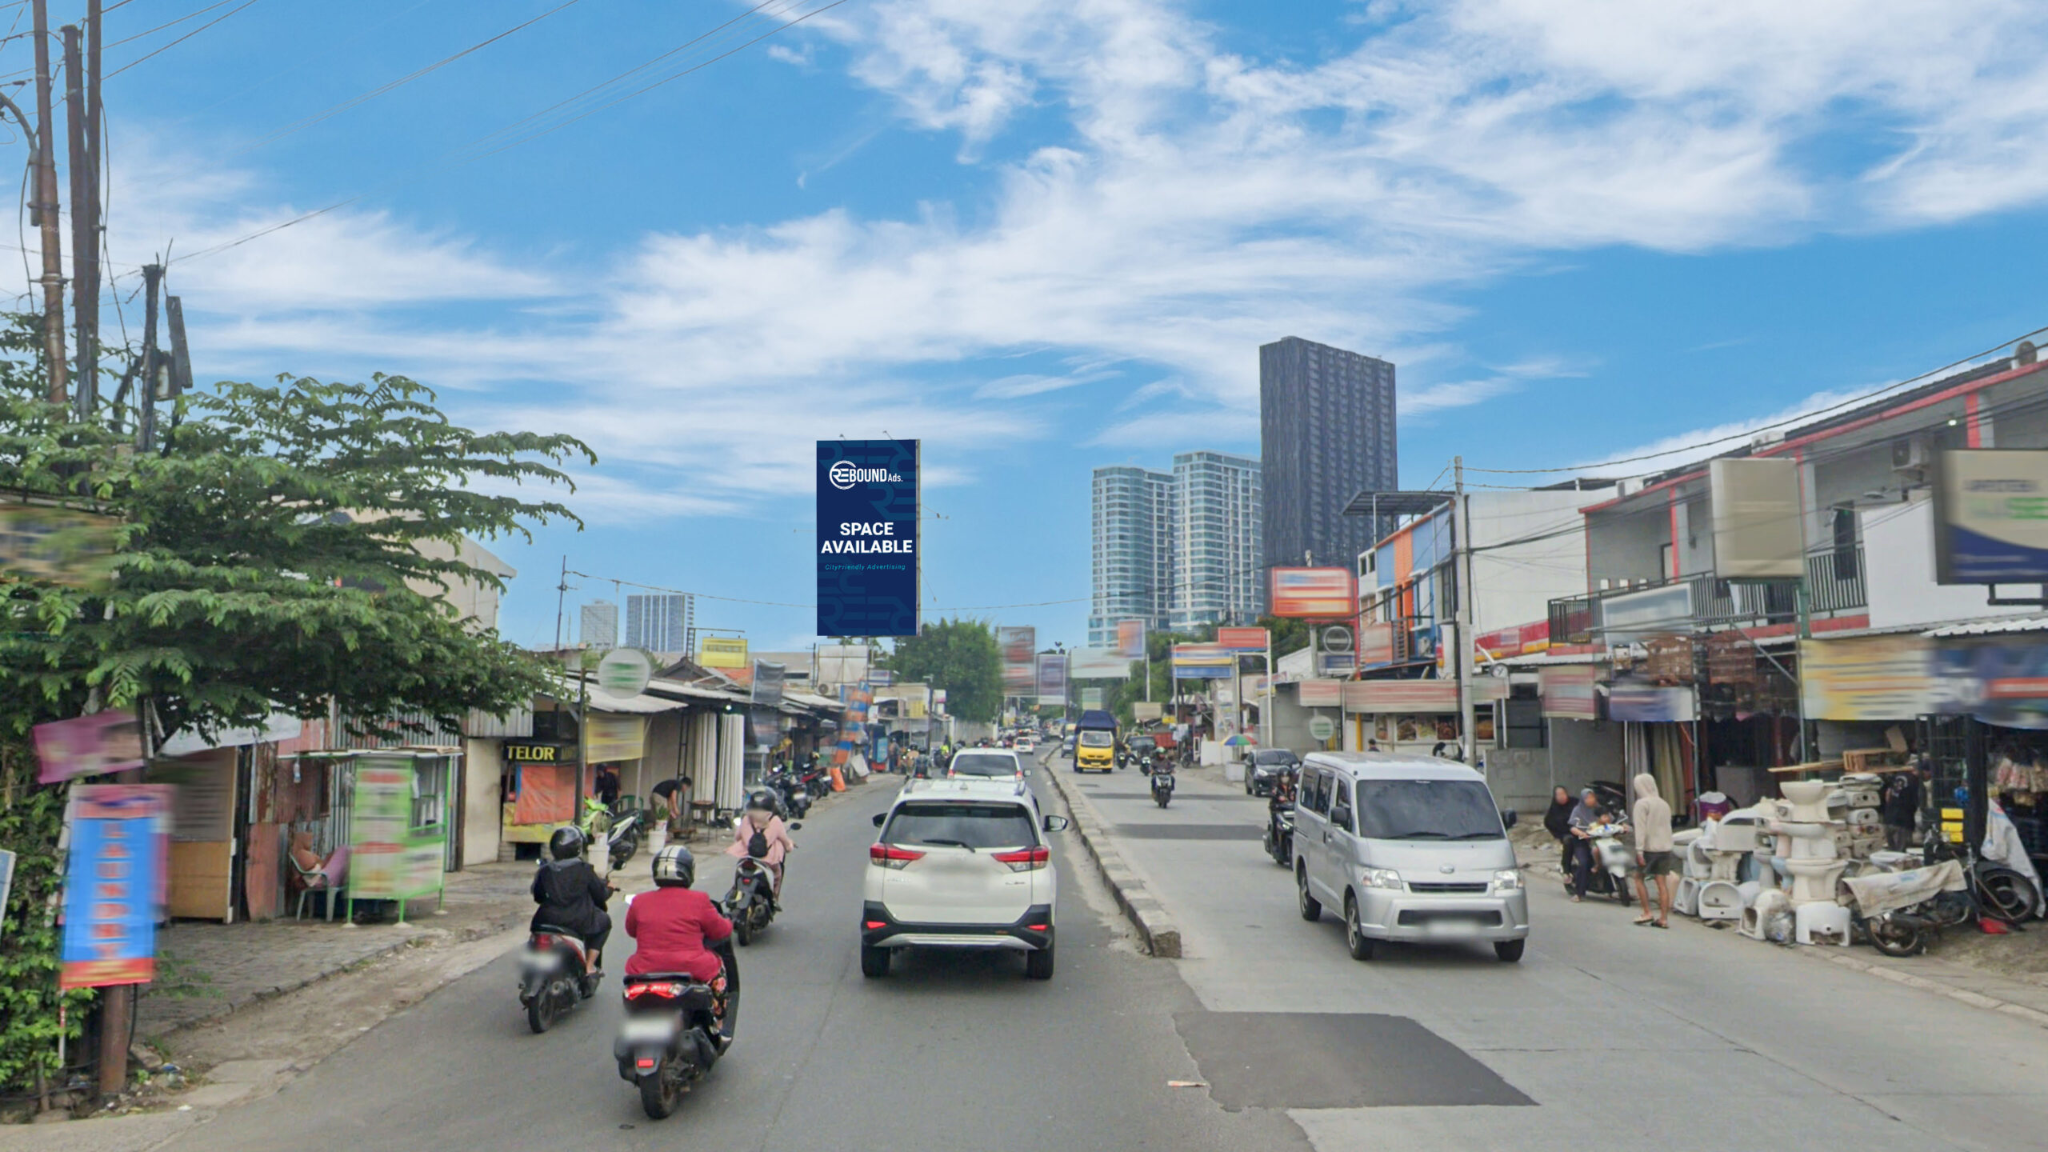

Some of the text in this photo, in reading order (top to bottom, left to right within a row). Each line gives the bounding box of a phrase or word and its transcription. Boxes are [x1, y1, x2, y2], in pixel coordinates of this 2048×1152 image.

[840, 522, 894, 536] SPACE
[821, 540, 913, 554] AVAILABLE
[866, 563, 906, 571] Advertising
[507, 745, 555, 760] TELOR
